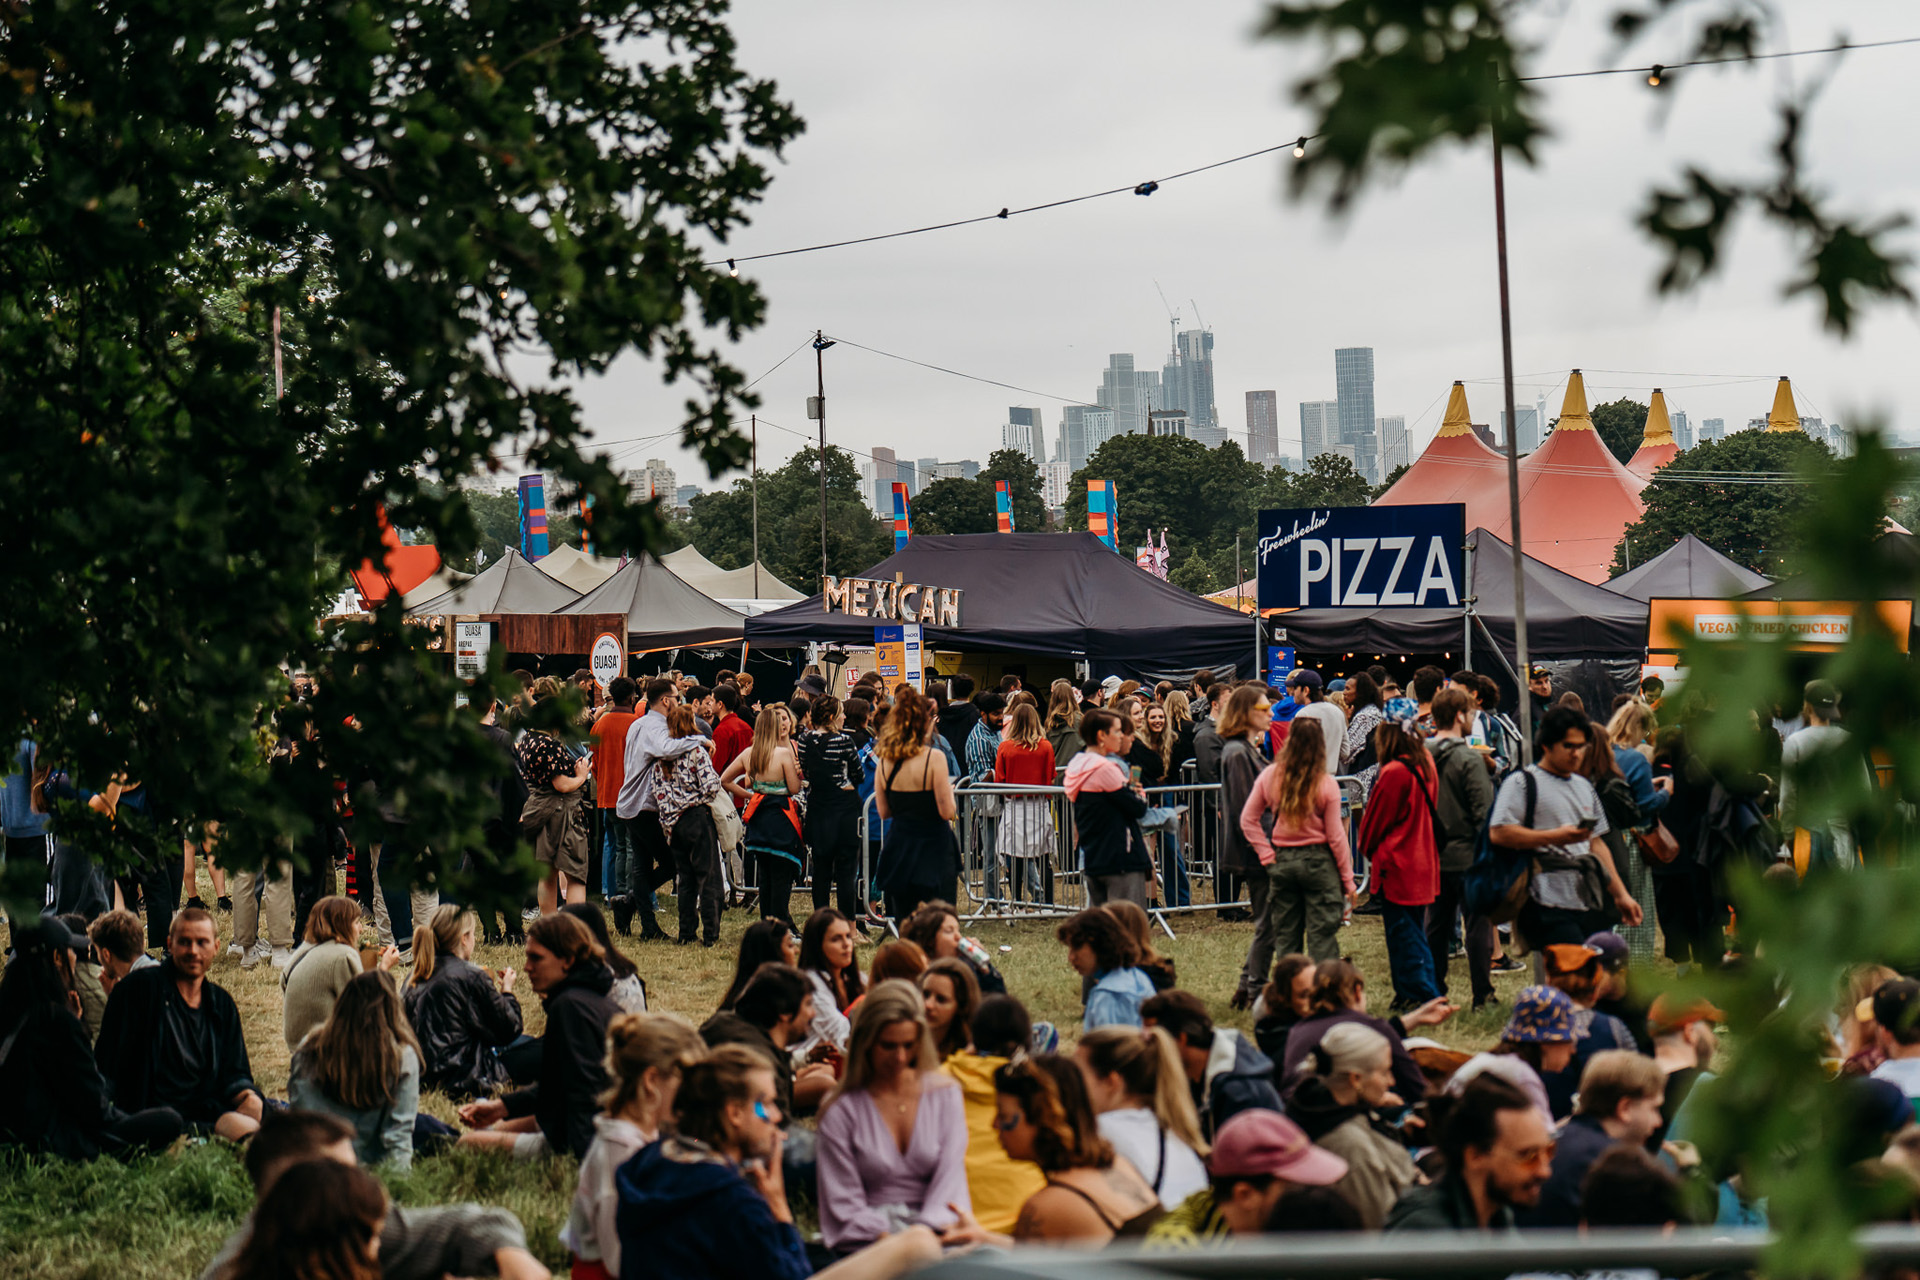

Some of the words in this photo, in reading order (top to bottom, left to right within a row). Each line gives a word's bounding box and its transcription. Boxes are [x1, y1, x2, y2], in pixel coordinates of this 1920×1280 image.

[1259, 511, 1330, 566] Freewheelin'
[1300, 535, 1459, 606] PIZZA
[822, 575, 963, 628] MEXICAN
[458, 640, 473, 648] AREPAS
[1698, 623, 1743, 634] VEGAN
[1748, 622, 1786, 634] FRIED
[1790, 623, 1850, 635] CHICKEN
